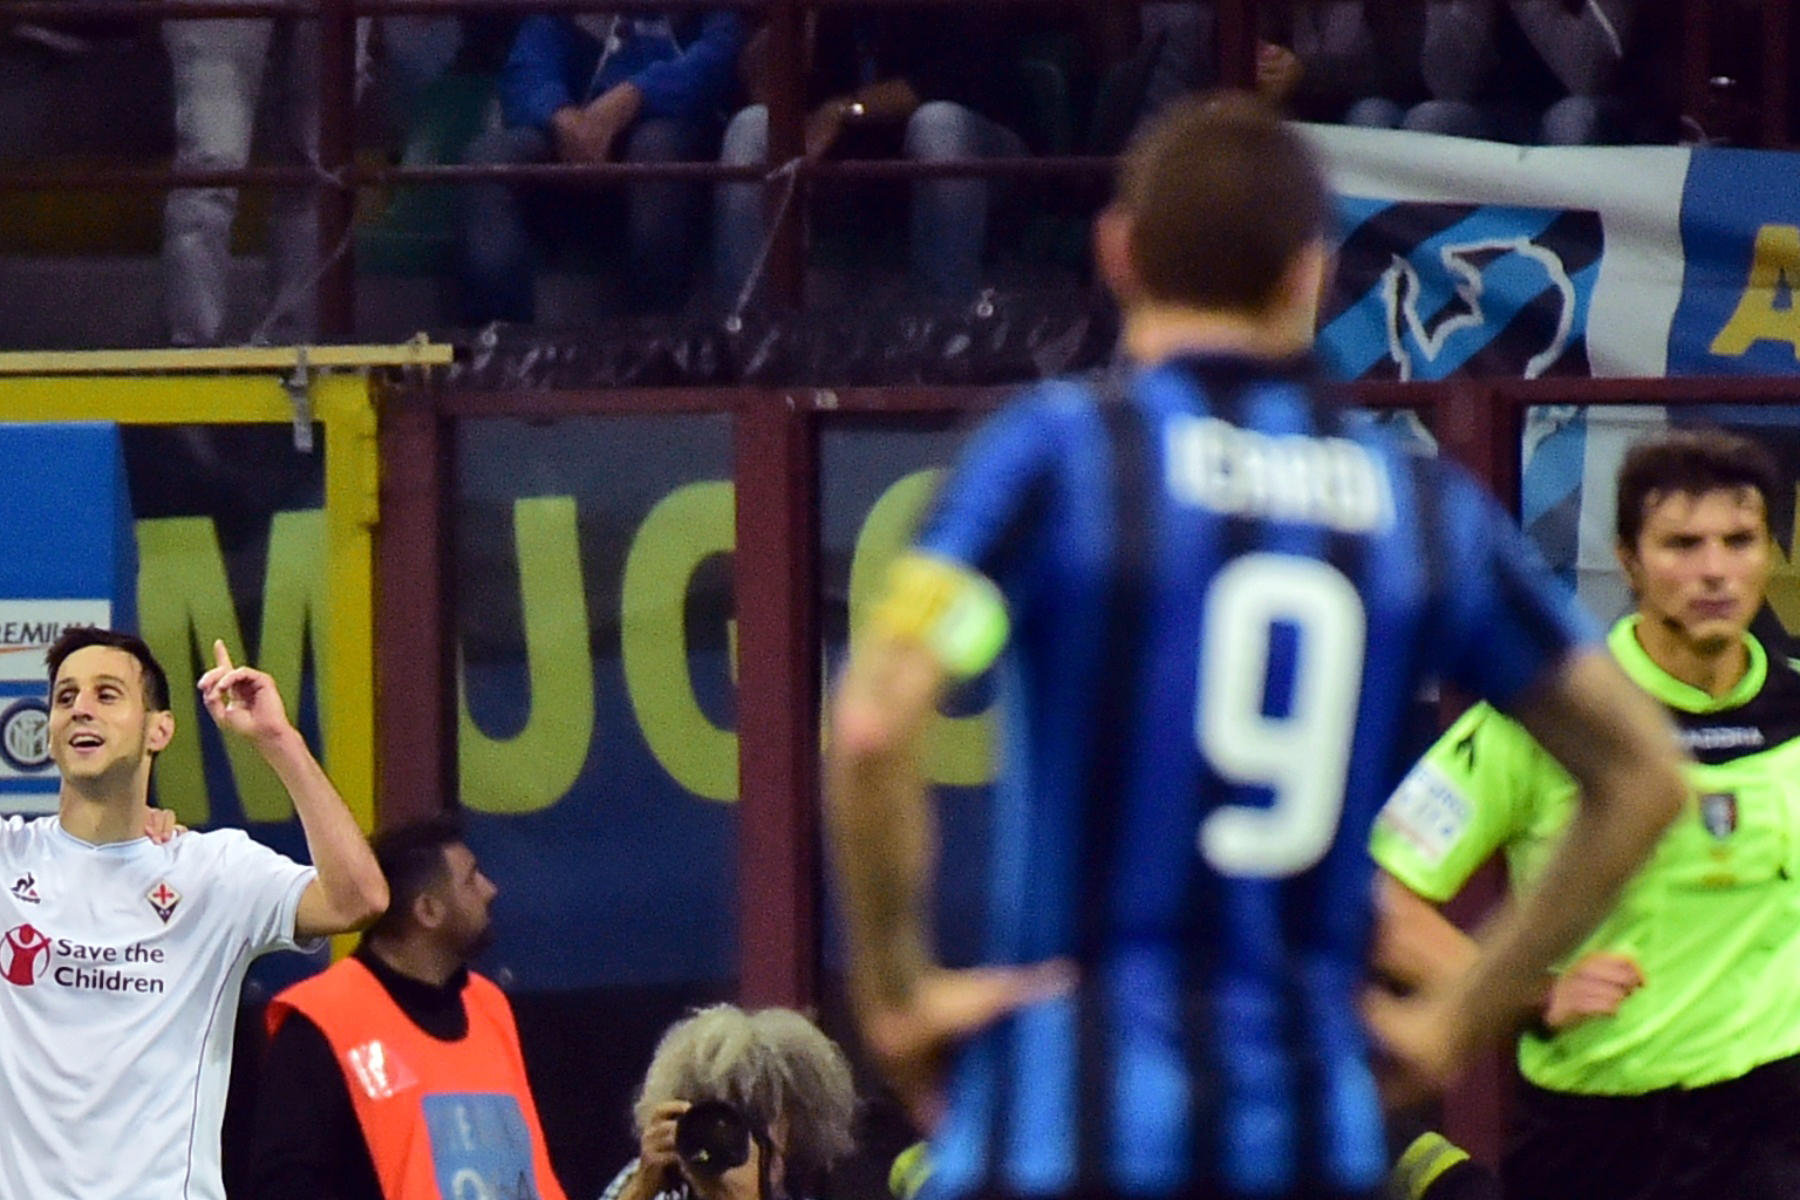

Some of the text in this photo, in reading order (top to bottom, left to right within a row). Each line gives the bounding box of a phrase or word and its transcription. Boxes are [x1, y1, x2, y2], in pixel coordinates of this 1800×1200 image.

[1195, 553, 1367, 876] 9
[57, 938, 164, 964] Save the
[54, 966, 164, 993] Children
